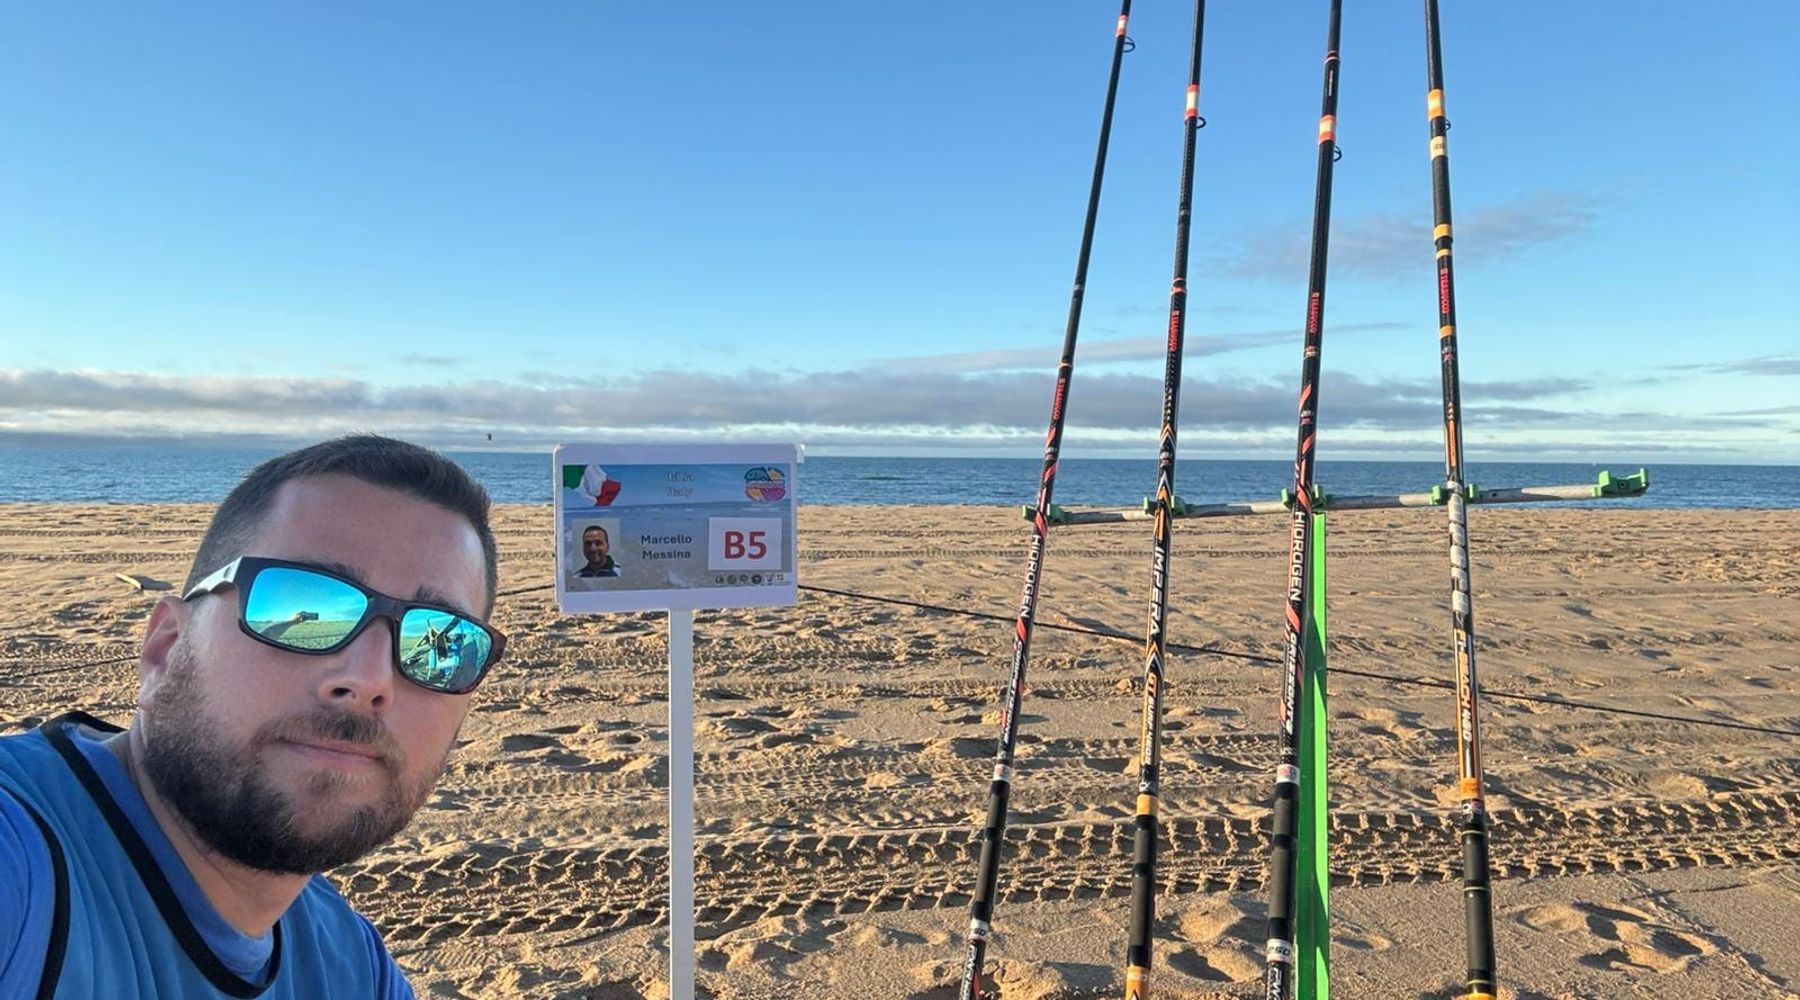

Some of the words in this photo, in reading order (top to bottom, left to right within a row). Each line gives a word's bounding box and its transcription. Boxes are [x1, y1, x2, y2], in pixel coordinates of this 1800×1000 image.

[641, 534, 692, 545] Marcello
[724, 531, 767, 560] B5
[642, 550, 691, 560] Messina
[1149, 546, 1166, 635] IMPERA
[1147, 672, 1157, 696] GT
